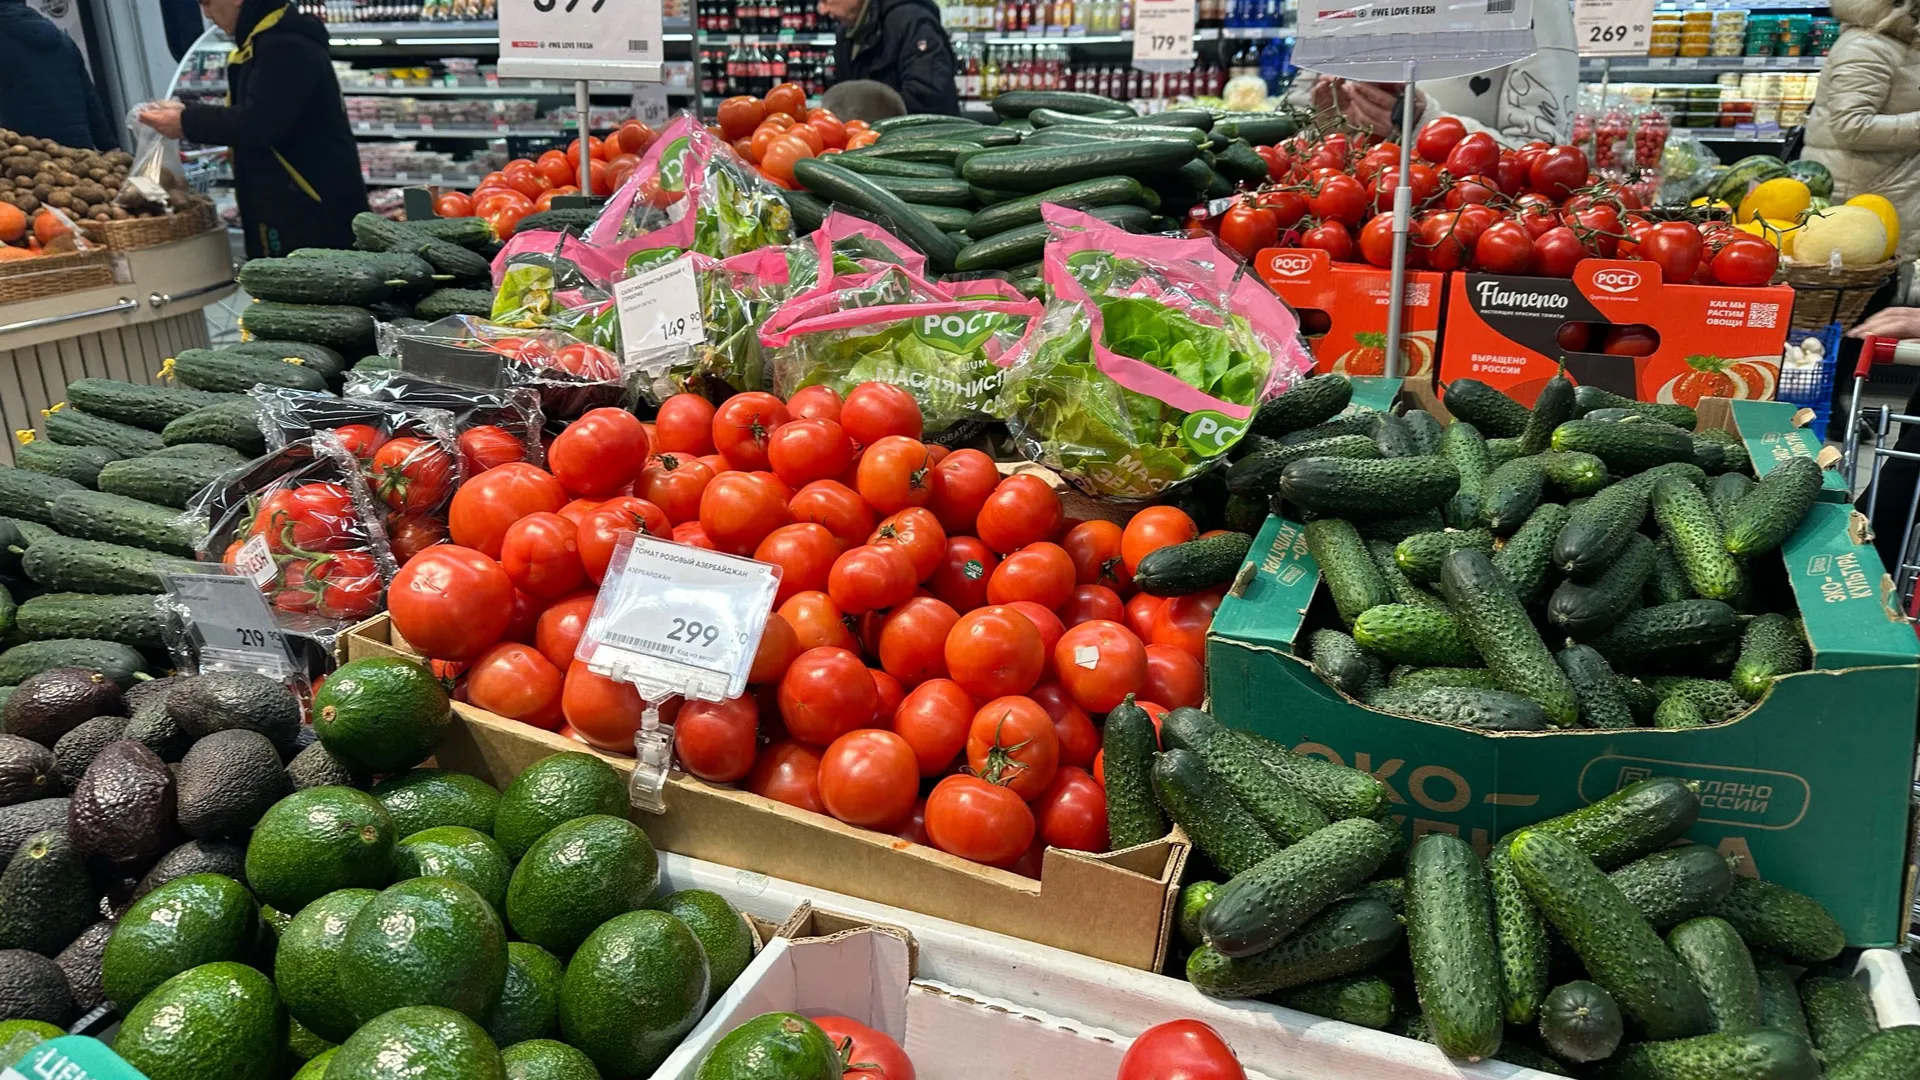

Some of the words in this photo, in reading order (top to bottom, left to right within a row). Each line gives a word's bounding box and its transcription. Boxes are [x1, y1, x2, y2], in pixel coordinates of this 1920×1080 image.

[1390, 7, 1409, 16] LOVE
[1411, 6, 1436, 14] FRESH
[1589, 25, 1627, 42] 269
[1152, 35, 1175, 50] 179
[1275, 258, 1308, 270] РОСТ
[1597, 273, 1637, 285] РОСТ
[1476, 281, 1569, 309] Flamenco
[1707, 309, 1744, 317] РАСТИМ
[661, 318, 685, 341] 149
[690, 311, 701, 323] 90
[923, 313, 998, 338] РОСТ
[1706, 318, 1743, 328] ОВОЩИ
[1471, 353, 1526, 366] ВЫРАЩЕНО
[1472, 364, 1479, 372] В
[1481, 365, 1521, 375] РОССИИ
[876, 367, 1008, 398] МАСЛЯНИСТ
[1261, 523, 1297, 574] КУЛЬТУРА
[634, 546, 659, 559] ТОМАТ
[659, 552, 695, 566] РОЗОВЫЙ
[695, 560, 749, 578] АЗЕРБАЙДЖАН
[627, 566, 671, 581] АЗЕРБАЙДЖАН
[1835, 552, 1873, 599] КУЛЬТУРА
[1820, 576, 1848, 603] ЭКО-
[237, 628, 265, 647] 219
[267, 631, 282, 642] 90
[667, 617, 720, 648] 299
[676, 648, 690, 657] Код
[690, 651, 698, 659] на
